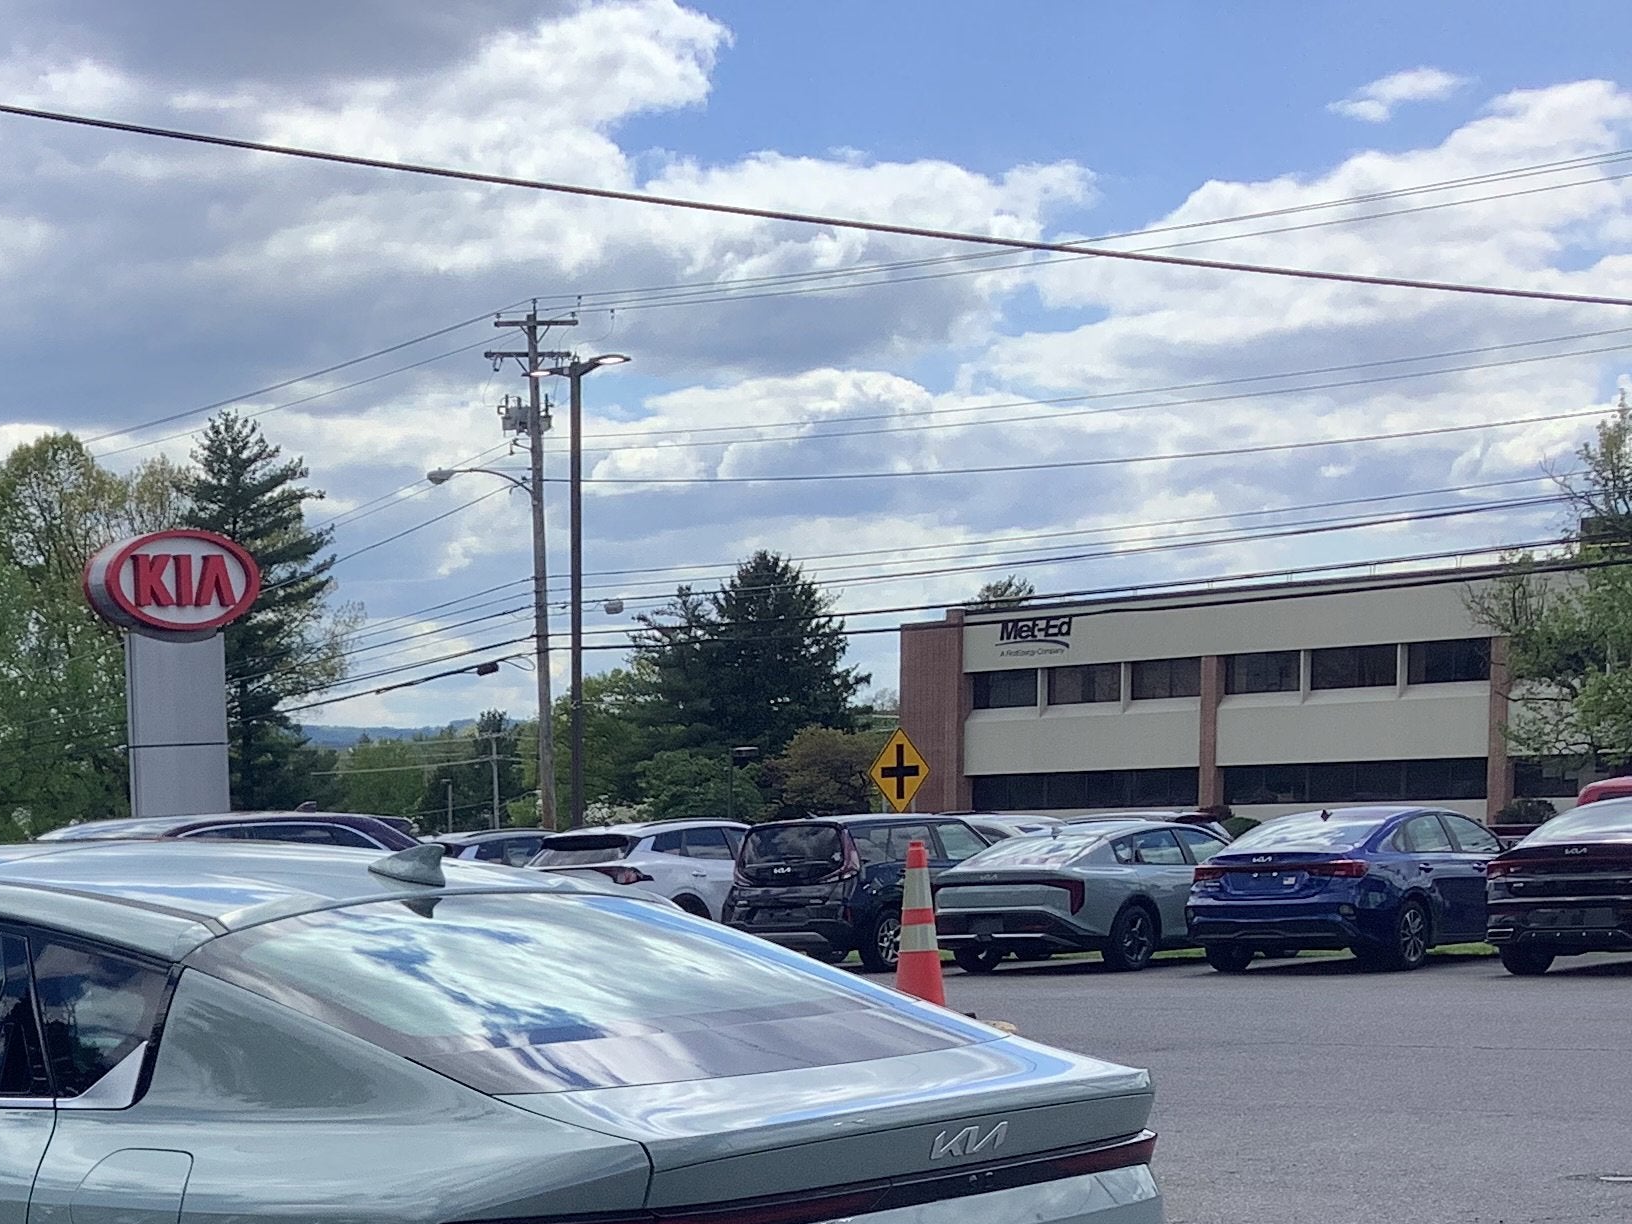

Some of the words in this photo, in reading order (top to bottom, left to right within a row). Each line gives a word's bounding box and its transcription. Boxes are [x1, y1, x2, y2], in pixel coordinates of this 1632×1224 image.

[130, 554, 236, 607] KIA
[999, 616, 1073, 641] Met-Ed
[929, 1120, 1009, 1160] KIA
